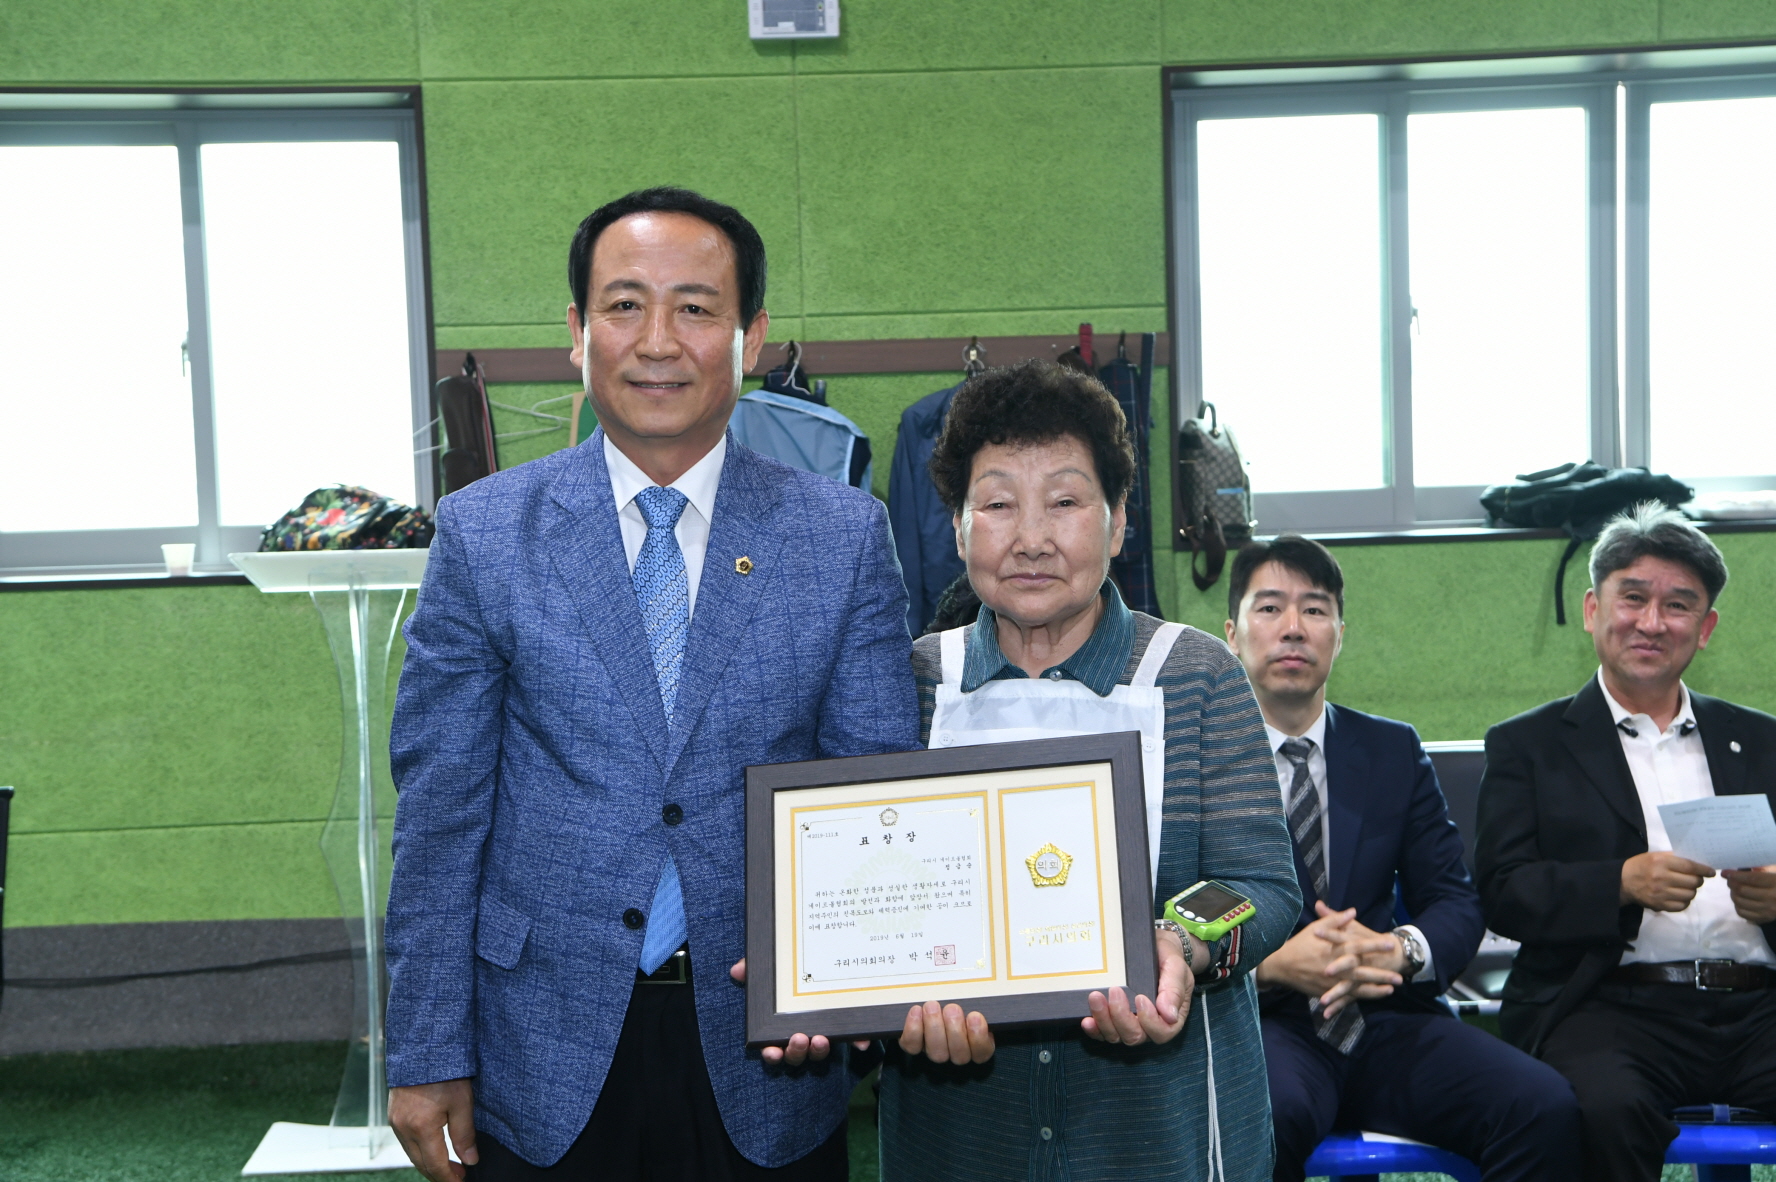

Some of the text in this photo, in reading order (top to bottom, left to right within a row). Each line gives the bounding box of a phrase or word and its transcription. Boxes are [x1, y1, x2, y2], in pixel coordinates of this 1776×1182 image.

[859, 831, 917, 846] 표 창 장
[1037, 859, 1059, 871] 의회
[950, 878, 971, 886] 구리시
[869, 934, 889, 942] 2019년
[1025, 929, 1092, 947] 구리시의회
[833, 954, 896, 968] 구리시의회의장
[908, 951, 918, 962] 박
